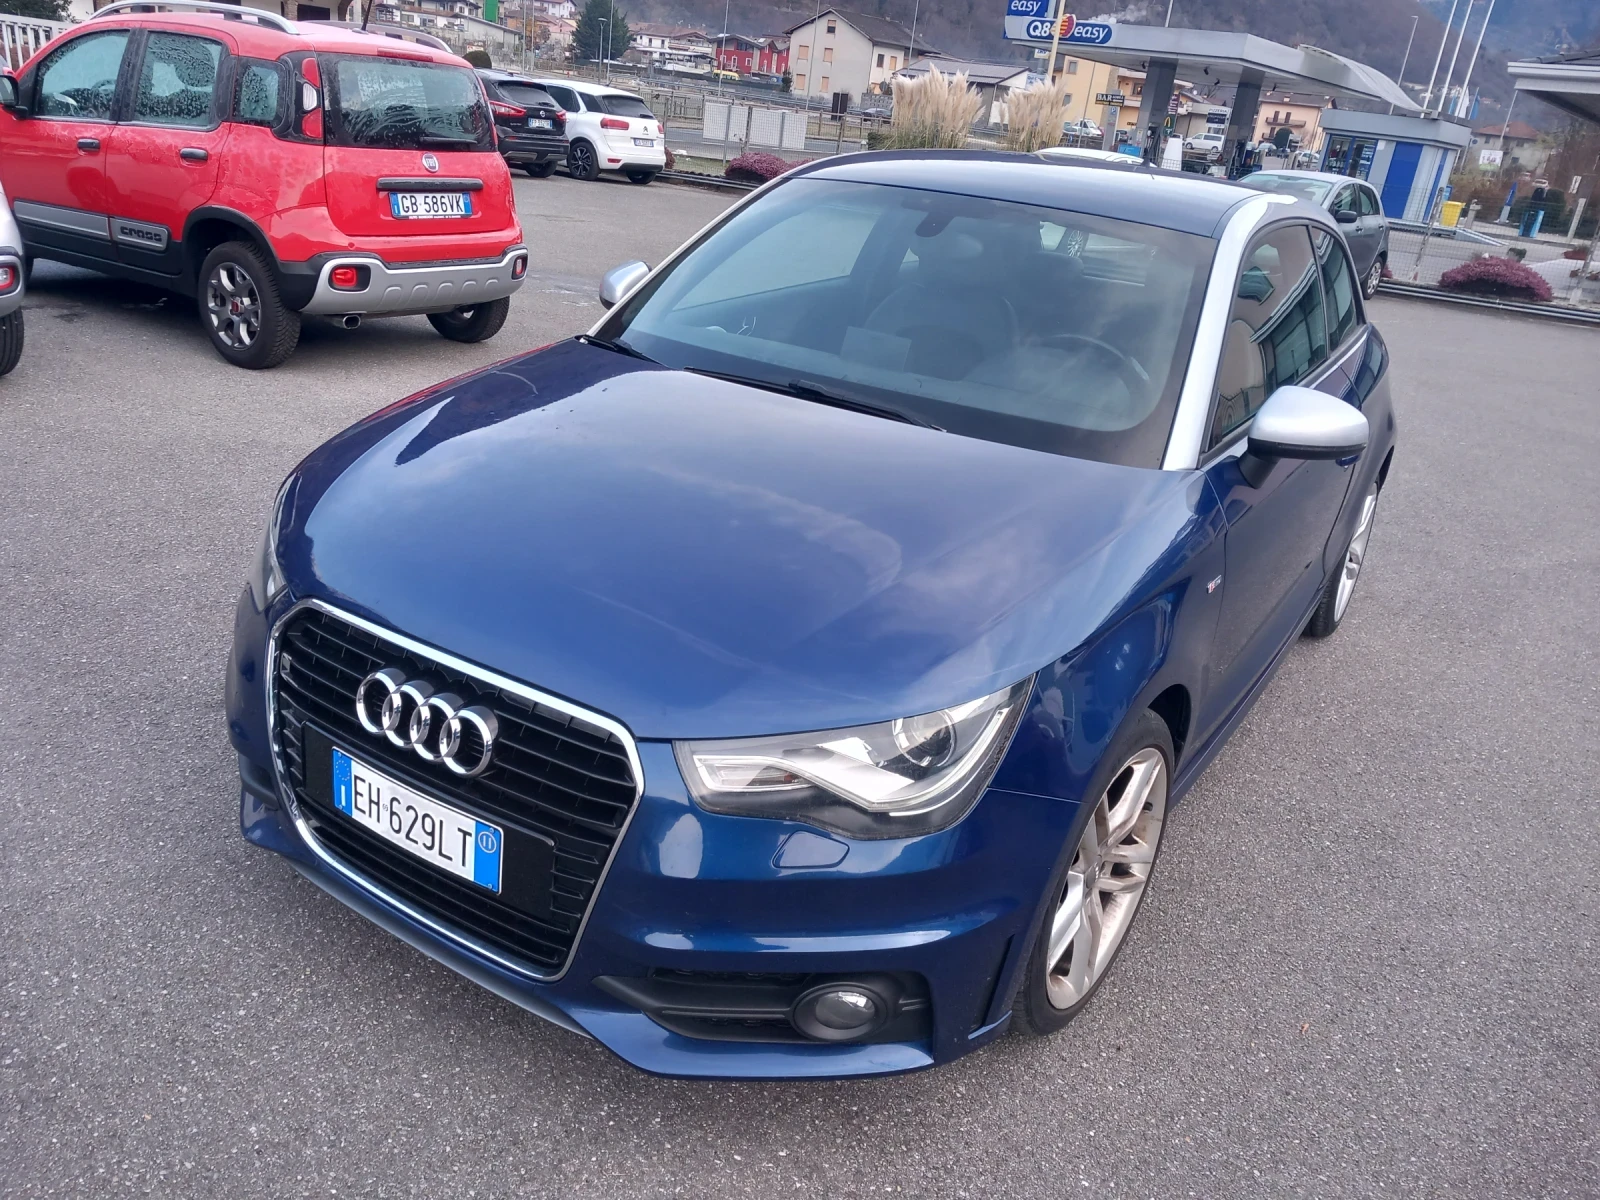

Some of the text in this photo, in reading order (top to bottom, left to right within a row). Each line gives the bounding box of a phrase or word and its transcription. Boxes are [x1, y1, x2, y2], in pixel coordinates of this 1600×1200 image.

[1011, 0, 1041, 15] easy
[1029, 21, 1109, 43] Q8 easy
[1097, 93, 1112, 101] BAR
[401, 195, 419, 213] GB
[423, 195, 464, 213] 586VK
[120, 226, 163, 242] cross
[353, 774, 381, 824] EH
[389, 796, 473, 868] 629LT
